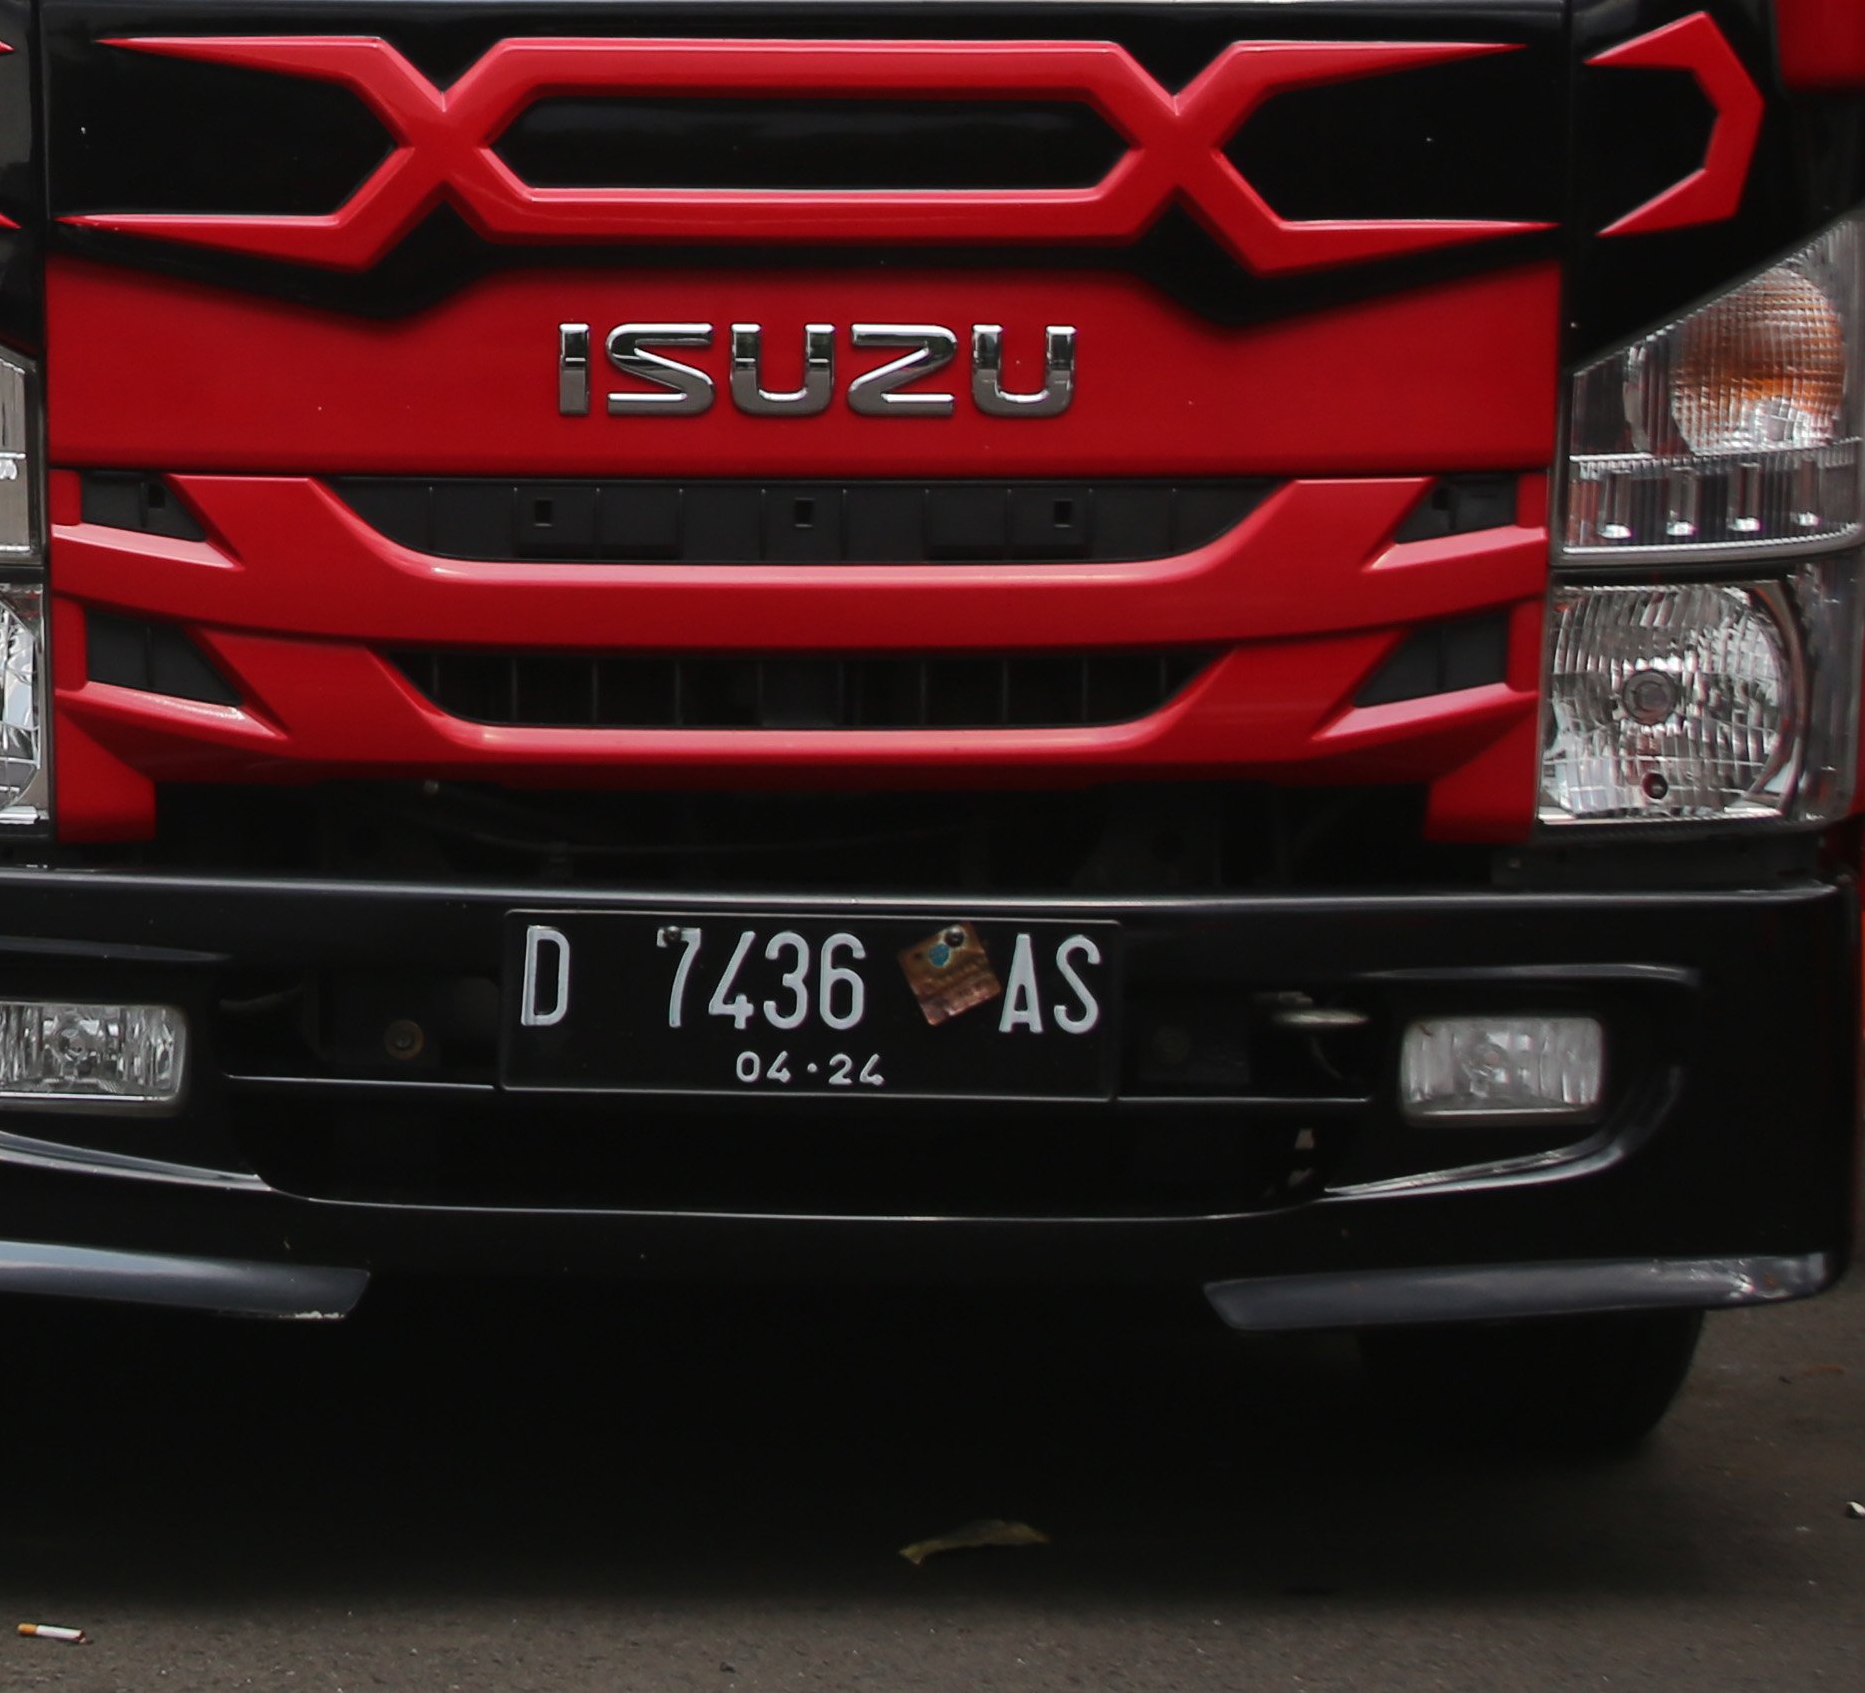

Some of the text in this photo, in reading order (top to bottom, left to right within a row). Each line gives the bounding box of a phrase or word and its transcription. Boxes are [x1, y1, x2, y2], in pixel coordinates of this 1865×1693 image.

[558, 322, 1078, 418] ISUZU
[520, 923, 1103, 1035] D 7436 AS
